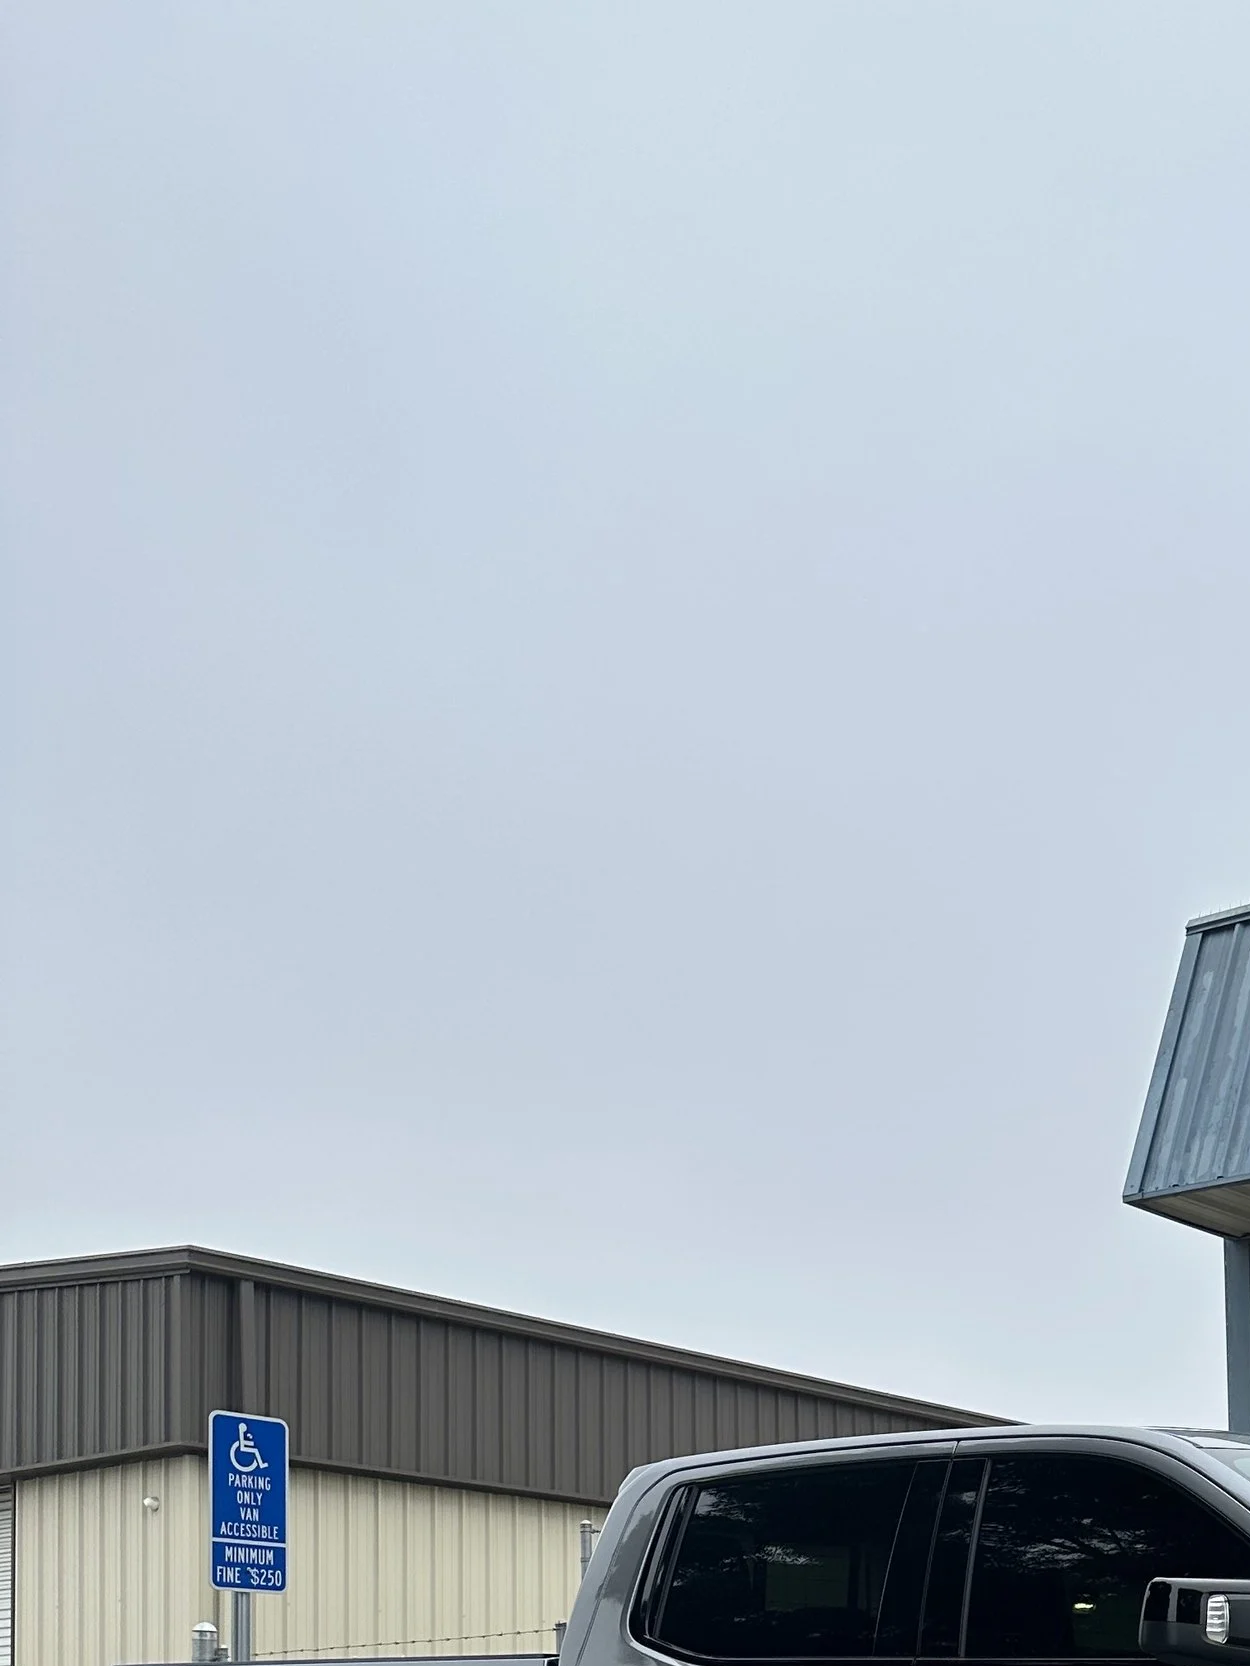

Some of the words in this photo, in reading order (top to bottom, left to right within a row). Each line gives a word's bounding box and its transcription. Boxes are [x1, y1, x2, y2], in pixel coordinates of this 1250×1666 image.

[228, 1472, 271, 1491] PARKING
[236, 1490, 263, 1506] ONLY
[239, 1507, 259, 1522] VAN
[220, 1521, 279, 1540] ACCESSIBLE
[224, 1545, 274, 1566] MINIMUM
[216, 1566, 241, 1584] FINE
[250, 1568, 282, 1587] $250
